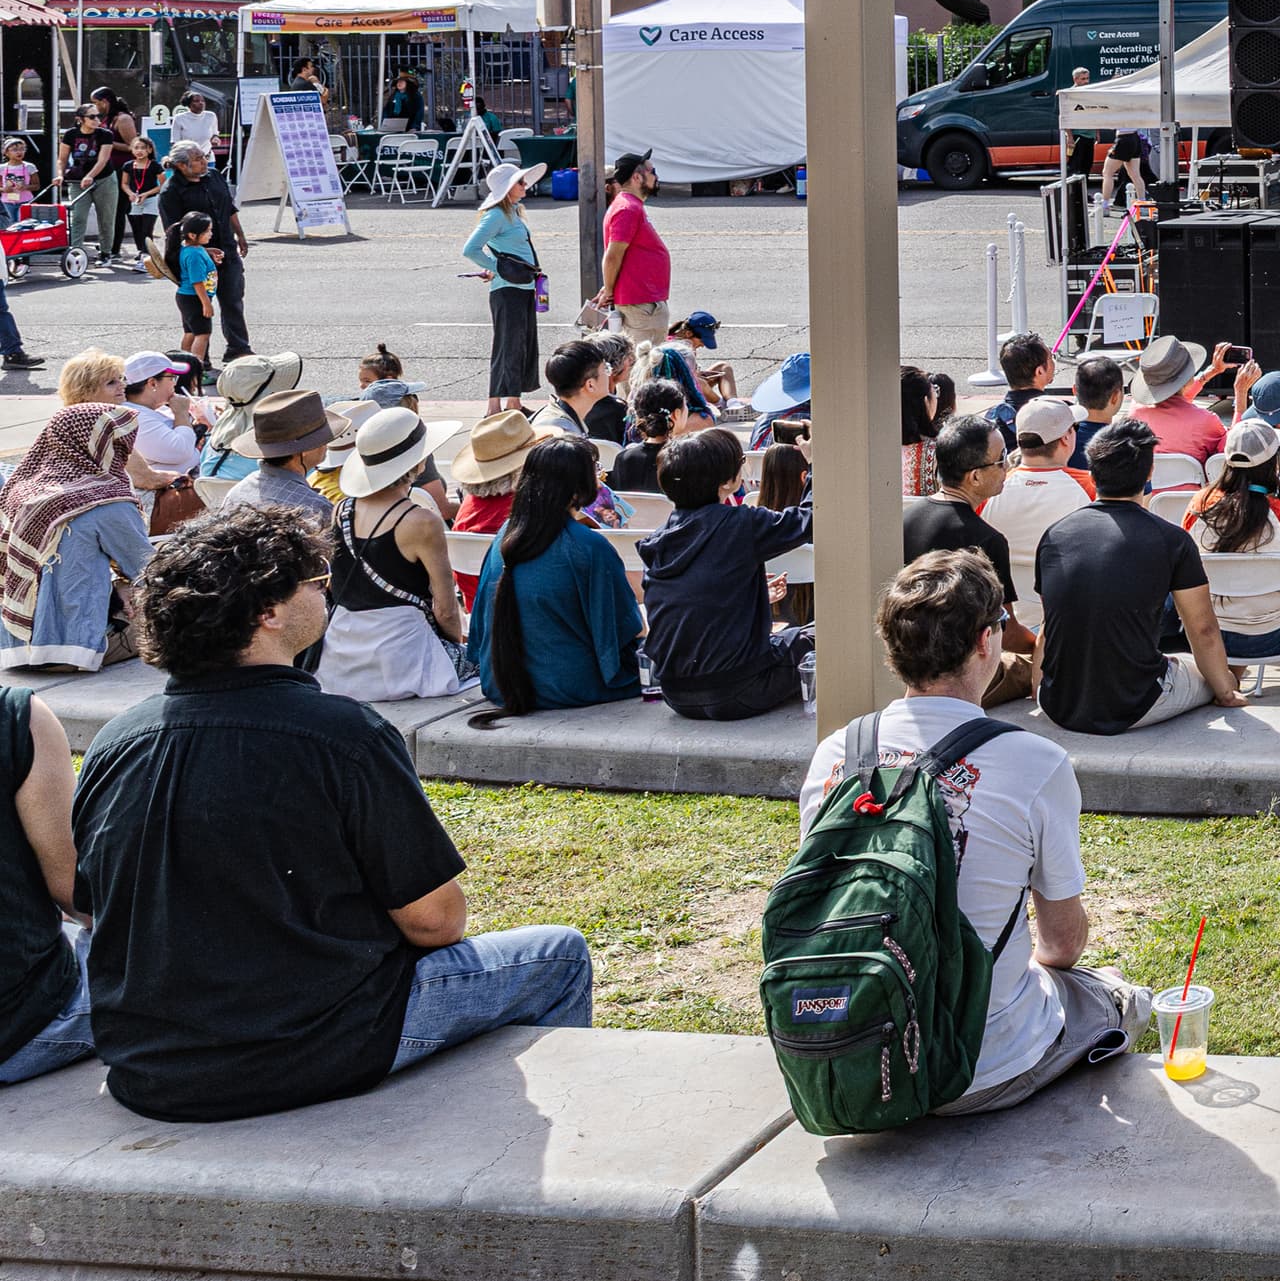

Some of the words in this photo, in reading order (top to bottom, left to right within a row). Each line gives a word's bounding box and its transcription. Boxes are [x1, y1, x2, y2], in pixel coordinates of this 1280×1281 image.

[315, 16, 343, 28] Care
[351, 16, 393, 27] Access
[669, 28, 707, 42] Care
[710, 27, 765, 41] Access
[1099, 31, 1115, 39] Care
[1099, 44, 1152, 54] Accelerating
[1100, 56, 1129, 65] Future
[1130, 55, 1140, 63] of
[1100, 67, 1113, 76] for
[795, 996, 848, 1016] JANSPORT
